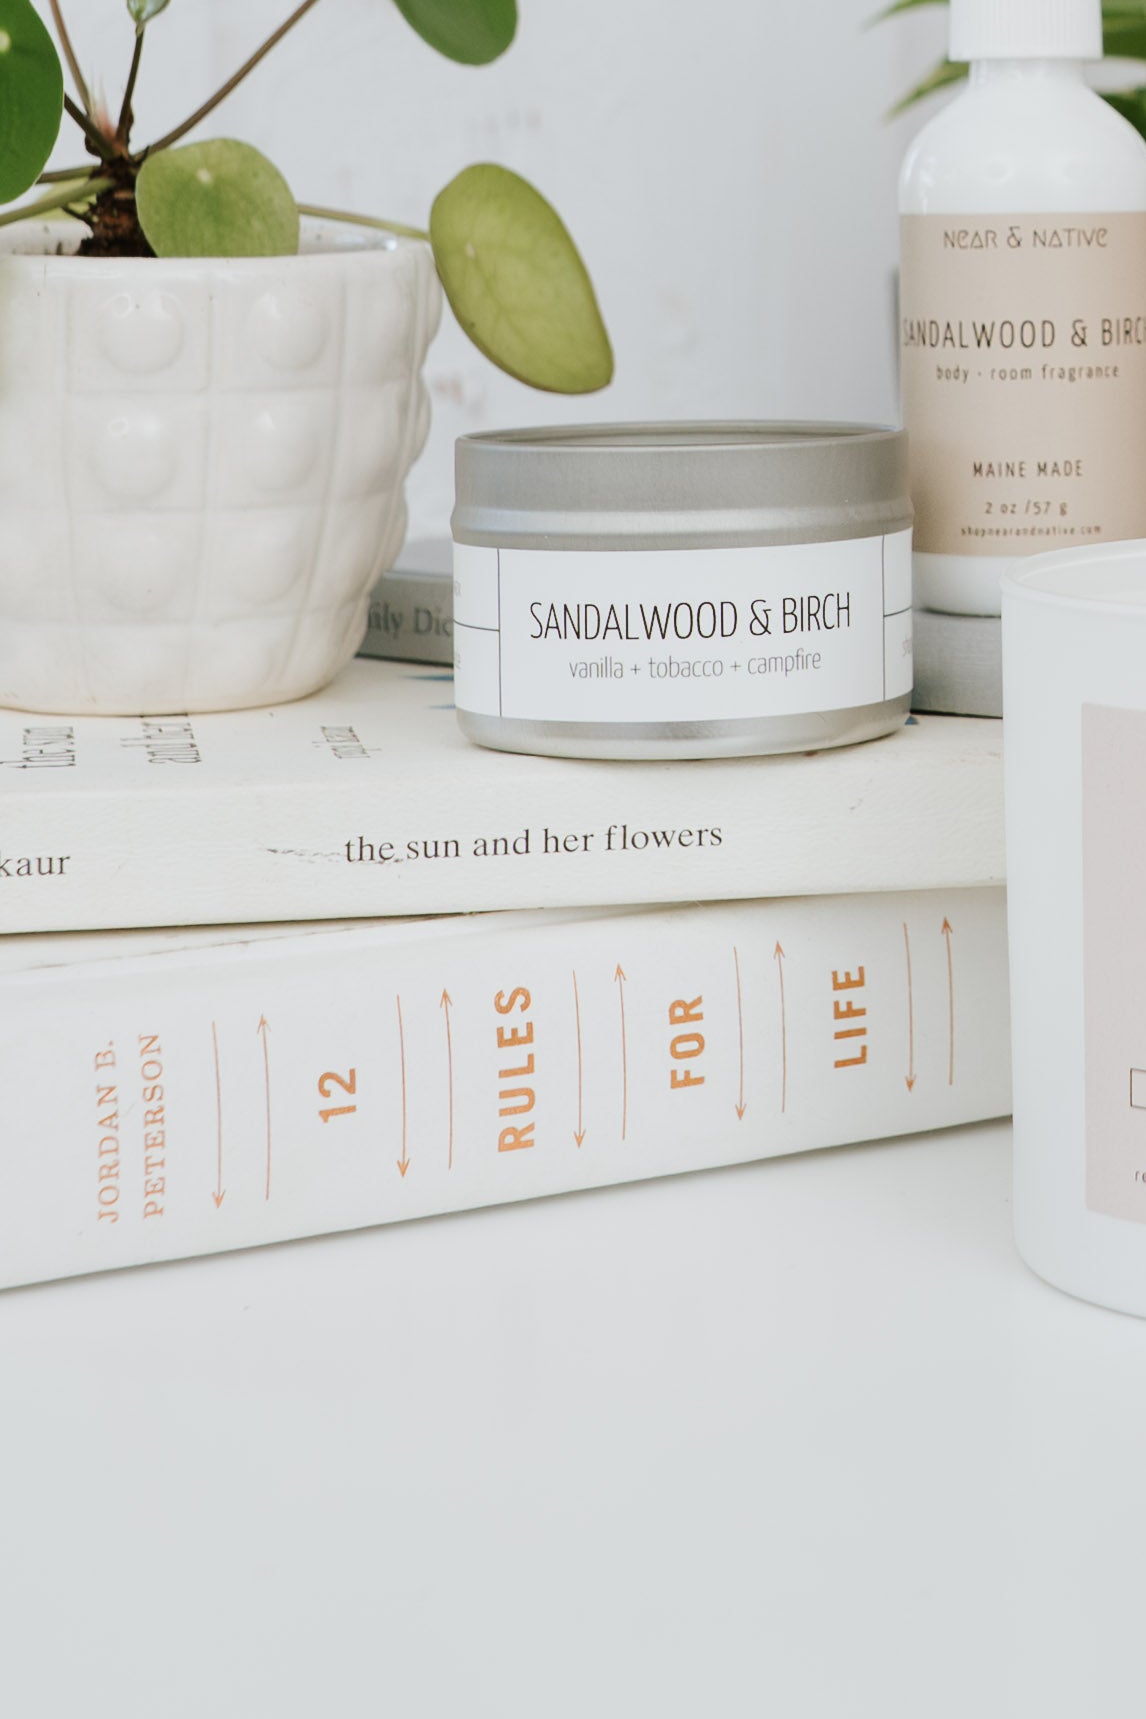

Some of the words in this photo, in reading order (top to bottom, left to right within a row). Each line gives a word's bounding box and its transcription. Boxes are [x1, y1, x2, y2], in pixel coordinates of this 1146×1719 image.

[943, 228, 999, 250] NEAR
[1006, 225, 1023, 250] &
[1031, 226, 1109, 249] NATIVE
[903, 319, 1056, 350] SANDALWOOD
[1070, 318, 1088, 348] &
[936, 364, 970, 385] body
[990, 367, 1033, 381] room
[1040, 363, 1120, 384] fragrance
[972, 460, 1026, 478] MAINE
[1036, 459, 1082, 477] MADE
[984, 501, 993, 515] 2
[999, 503, 1017, 515] oz
[1024, 499, 1052, 516] /57
[1059, 501, 1068, 517] g
[529, 601, 738, 641] SANDALWOOD
[749, 598, 772, 637] &
[782, 591, 850, 634] BIRCH
[568, 655, 624, 680] vanilla
[629, 663, 641, 676] +
[647, 655, 724, 679] tobacco
[728, 660, 742, 673] +
[747, 647, 822, 678] campfire
[344, 835, 399, 865] the
[406, 839, 460, 860] sun
[472, 828, 531, 857] and
[543, 827, 595, 854] her
[605, 824, 723, 851] flowers
[831, 965, 868, 1069] LIFE
[94, 1040, 117, 1071] B.
[668, 995, 706, 1090] FOR
[493, 986, 536, 1153] RULES
[317, 1067, 358, 1124] 12
[137, 1034, 166, 1219] PETERSON
[95, 1084, 121, 1224] JORDAN
